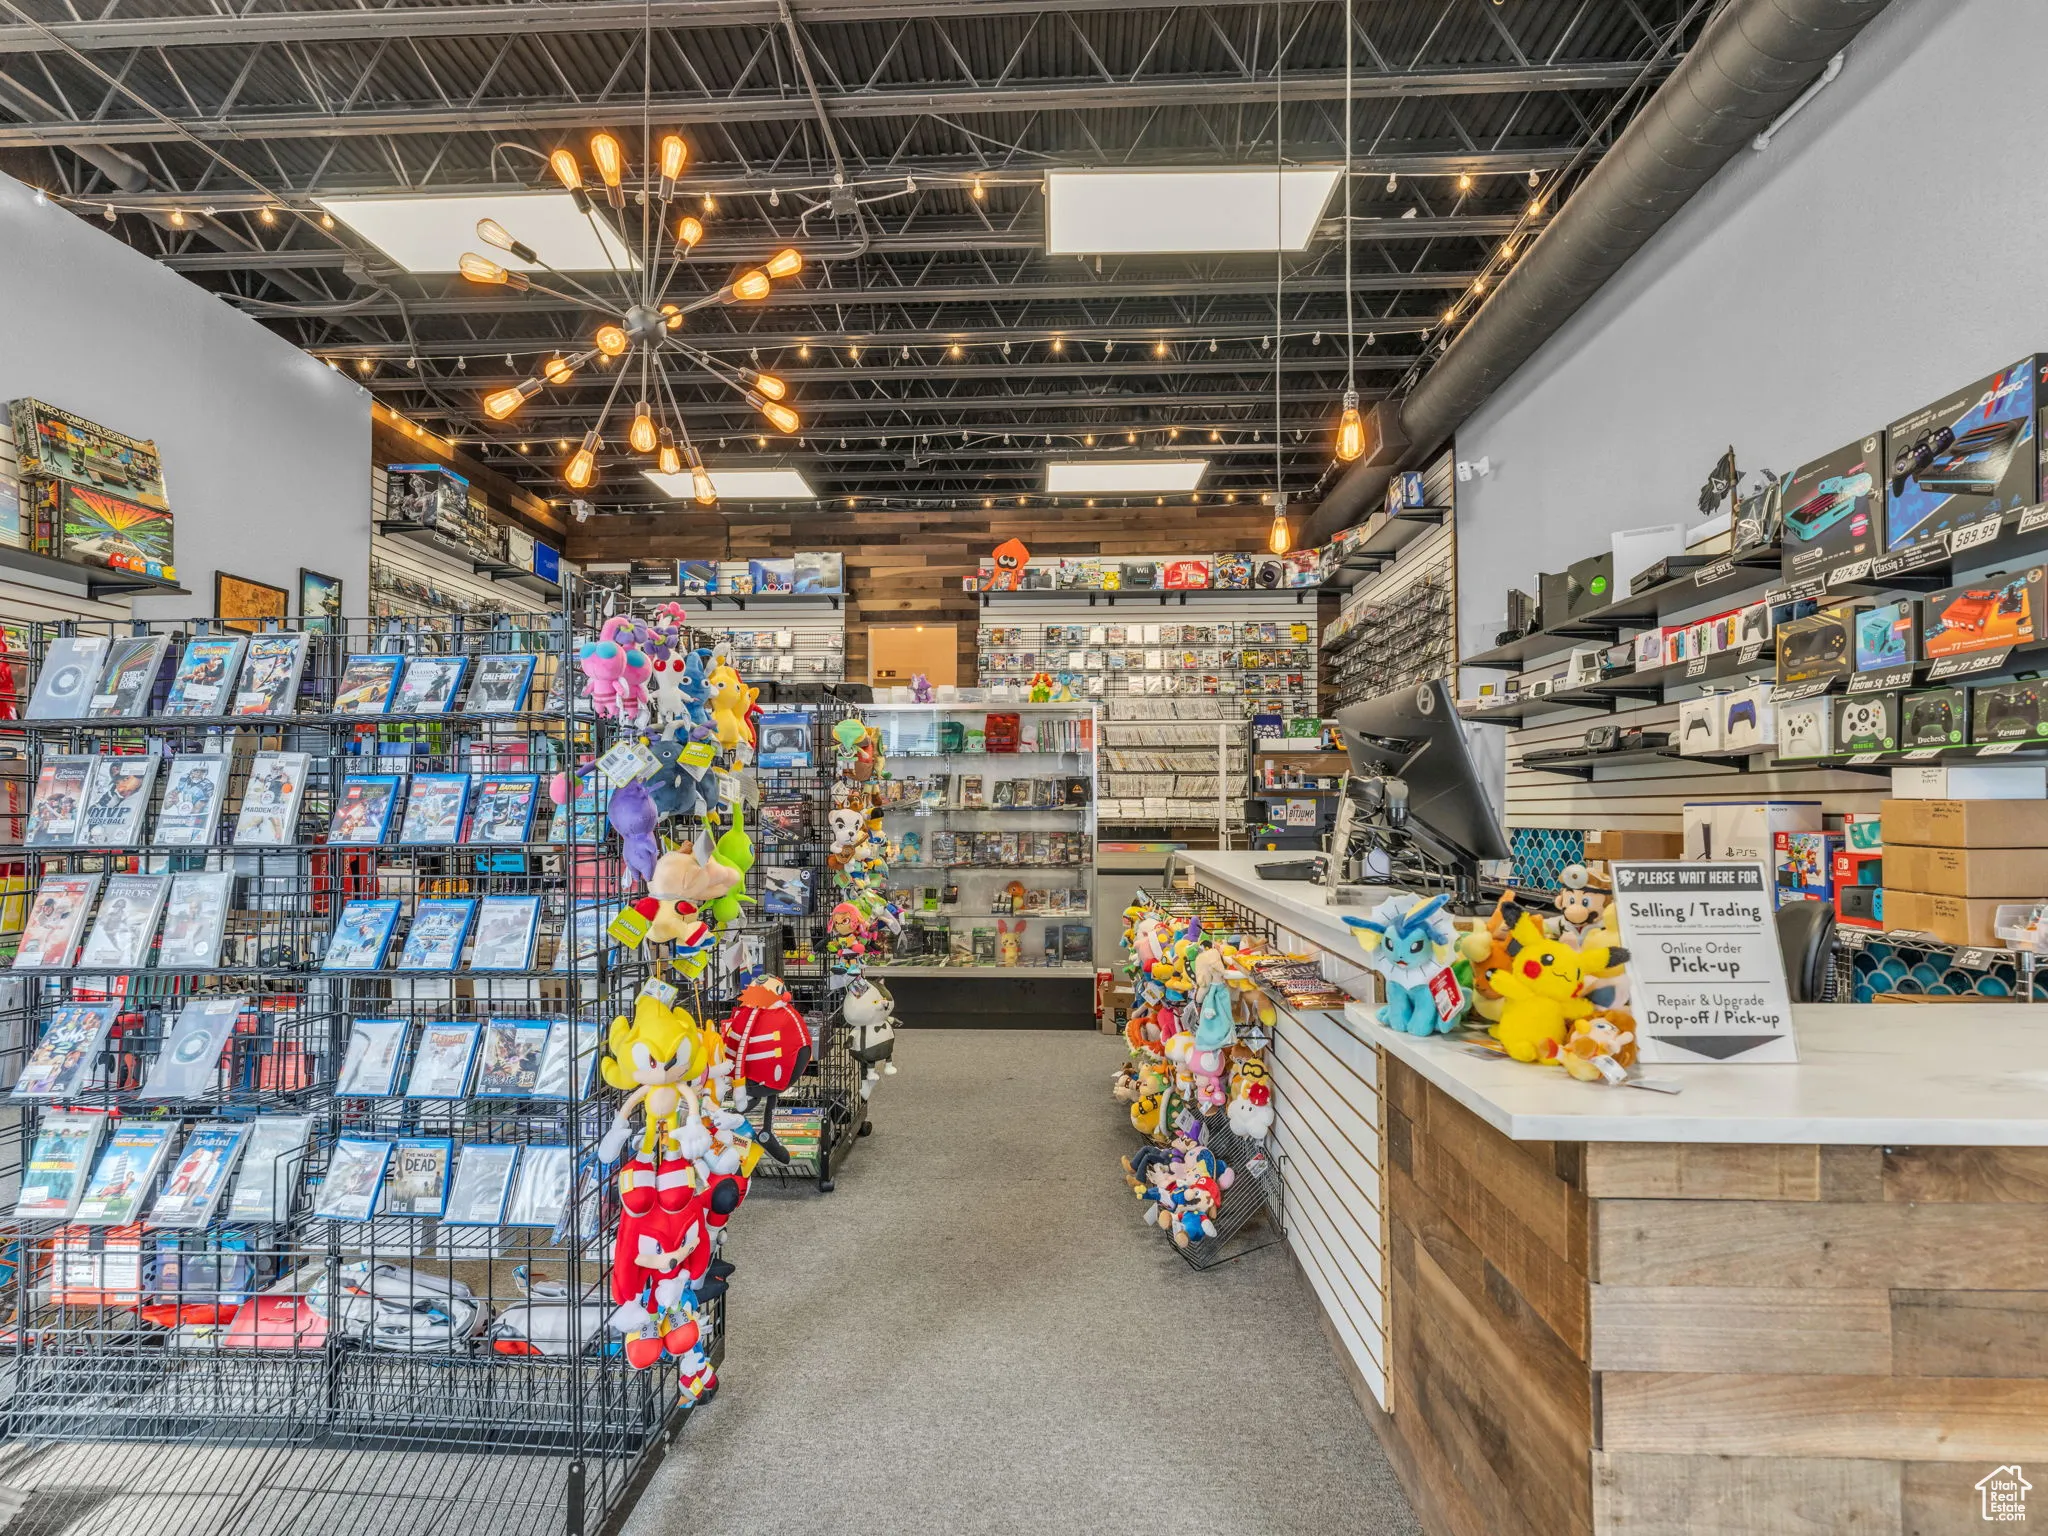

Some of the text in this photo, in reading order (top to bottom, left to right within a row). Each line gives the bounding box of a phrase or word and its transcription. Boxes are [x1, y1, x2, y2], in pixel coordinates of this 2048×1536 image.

[26, 413, 36, 440] COMPUTER
[33, 400, 130, 442] VIDEO COMPUTER SYSTEM
[1956, 523, 1996, 548] $89.99
[1136, 566, 1149, 574] Wii
[1180, 563, 1193, 571] Wii
[1832, 562, 1870, 582] $174.99
[1875, 558, 1904, 574] Classiq 3
[1951, 642, 1962, 651] 77
[1933, 665, 1958, 676] Retron
[1958, 661, 1972, 671] 77
[1970, 654, 2004, 670] $89.99
[482, 673, 496, 681] CALL
[1852, 673, 1911, 690] Retron Sq $89.99
[89, 806, 131, 818] MVP
[775, 809, 800, 817] CABLE
[1289, 809, 1315, 818] BITJUMP
[87, 817, 126, 825] BASEBALL
[1735, 849, 1758, 857] PS5
[1638, 870, 1758, 885] PLEASE WAIT HERE FOR
[110, 888, 152, 897] HEROES
[1630, 902, 1762, 922] Selling / Trading
[618, 918, 642, 936] PIKMIN
[1661, 942, 1742, 954] Online Order
[1963, 950, 1982, 959] PSP
[1669, 956, 1740, 979] Pick-up
[1657, 994, 1765, 1010] Repair & Upgrade
[1647, 1011, 1780, 1029] Drop-off / Pick-up
[431, 1032, 468, 1044] RAYMAN
[405, 1158, 437, 1172] DEAD
